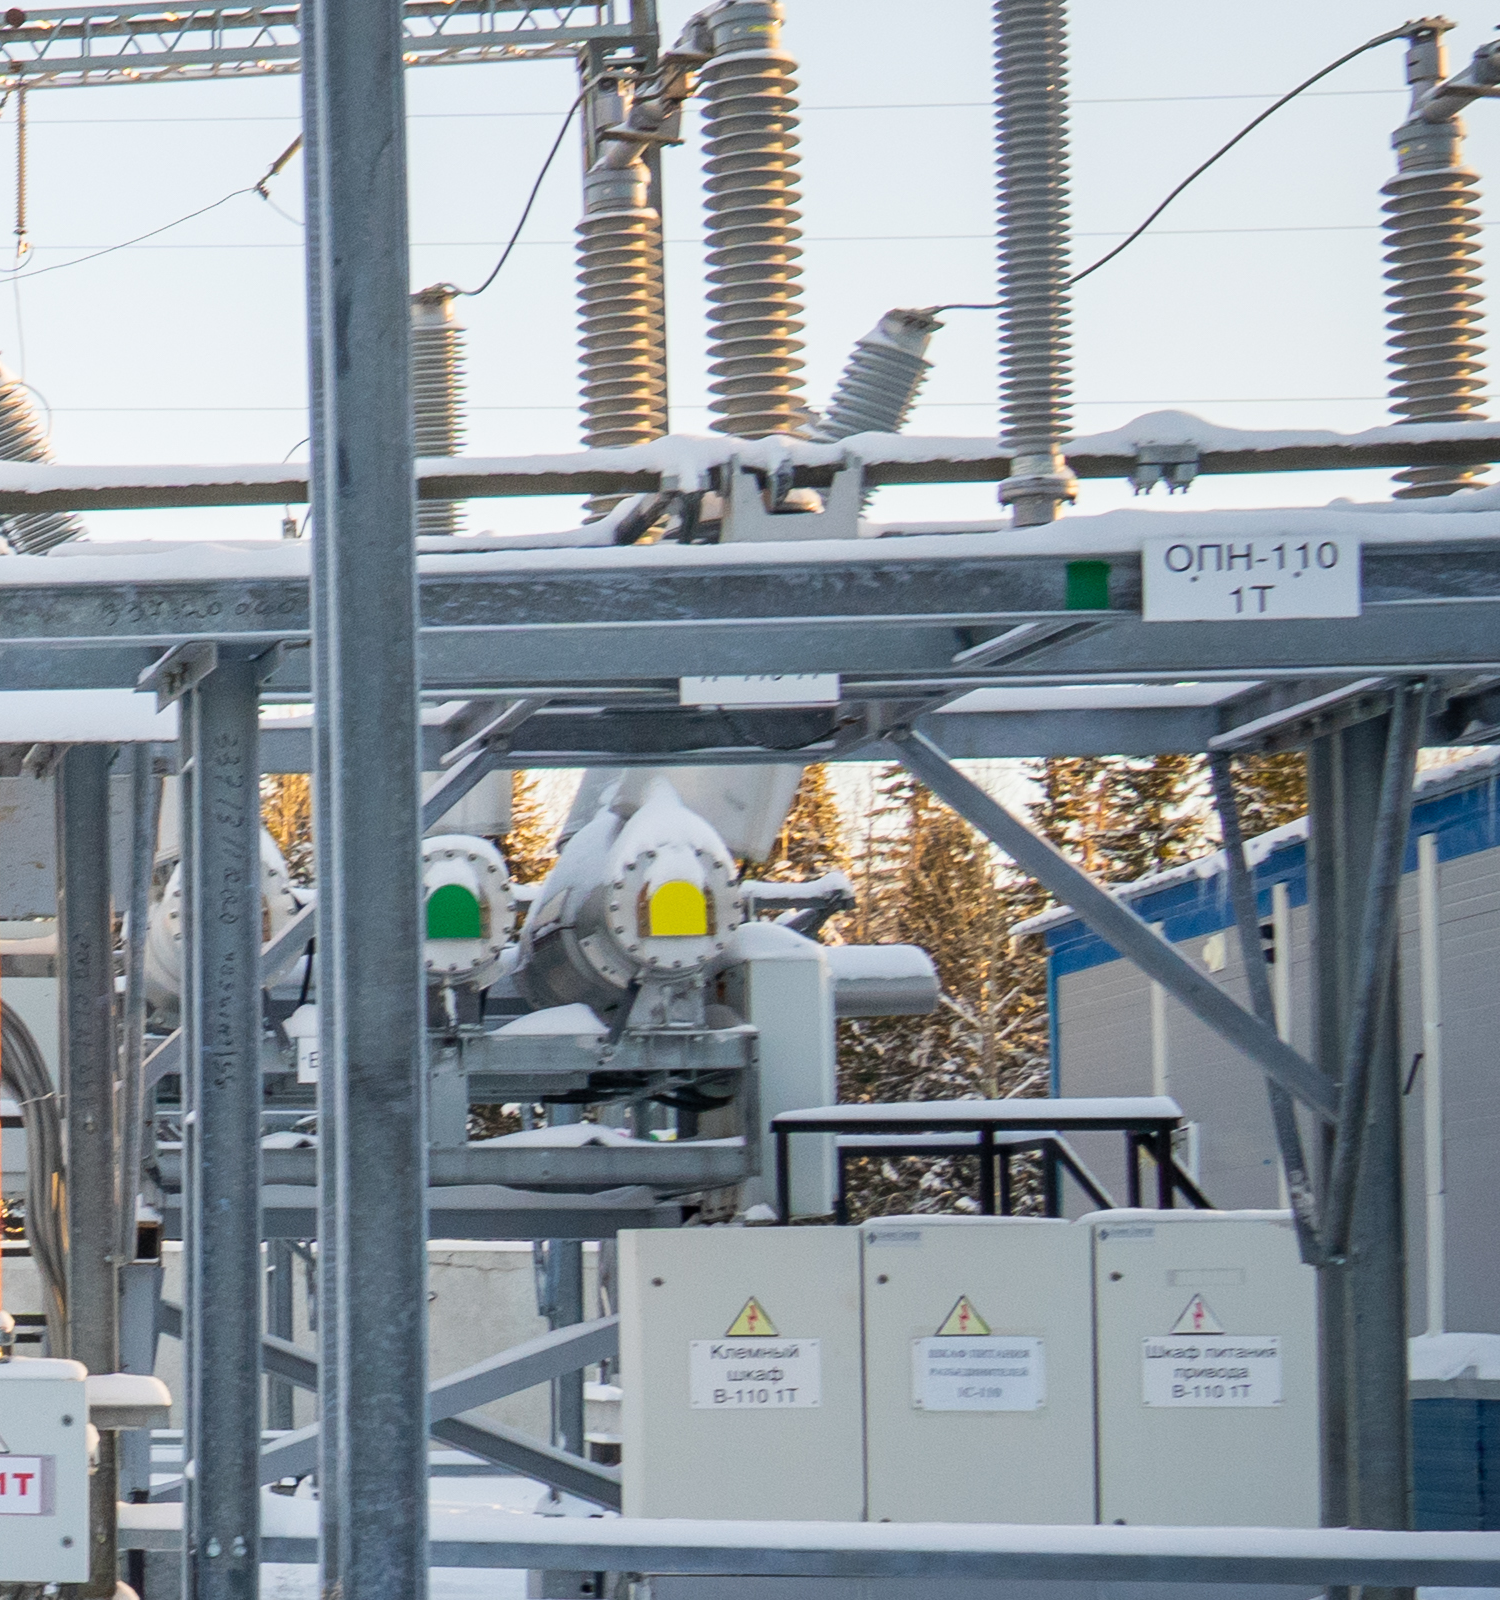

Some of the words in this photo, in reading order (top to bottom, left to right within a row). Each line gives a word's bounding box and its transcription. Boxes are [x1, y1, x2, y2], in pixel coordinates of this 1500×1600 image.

[1164, 541, 1339, 573] ОПН-110
[1229, 585, 1276, 614] 1Т
[1145, 1345, 1201, 1361] Шкаф
[1204, 1347, 1277, 1359] питания
[726, 1366, 785, 1385] шкаф
[1173, 1367, 1249, 1382] привода
[713, 1388, 770, 1404] В-110
[775, 1388, 799, 1403] 1Т
[1172, 1384, 1225, 1398] В-110
[1229, 1384, 1253, 1398] 1Т
